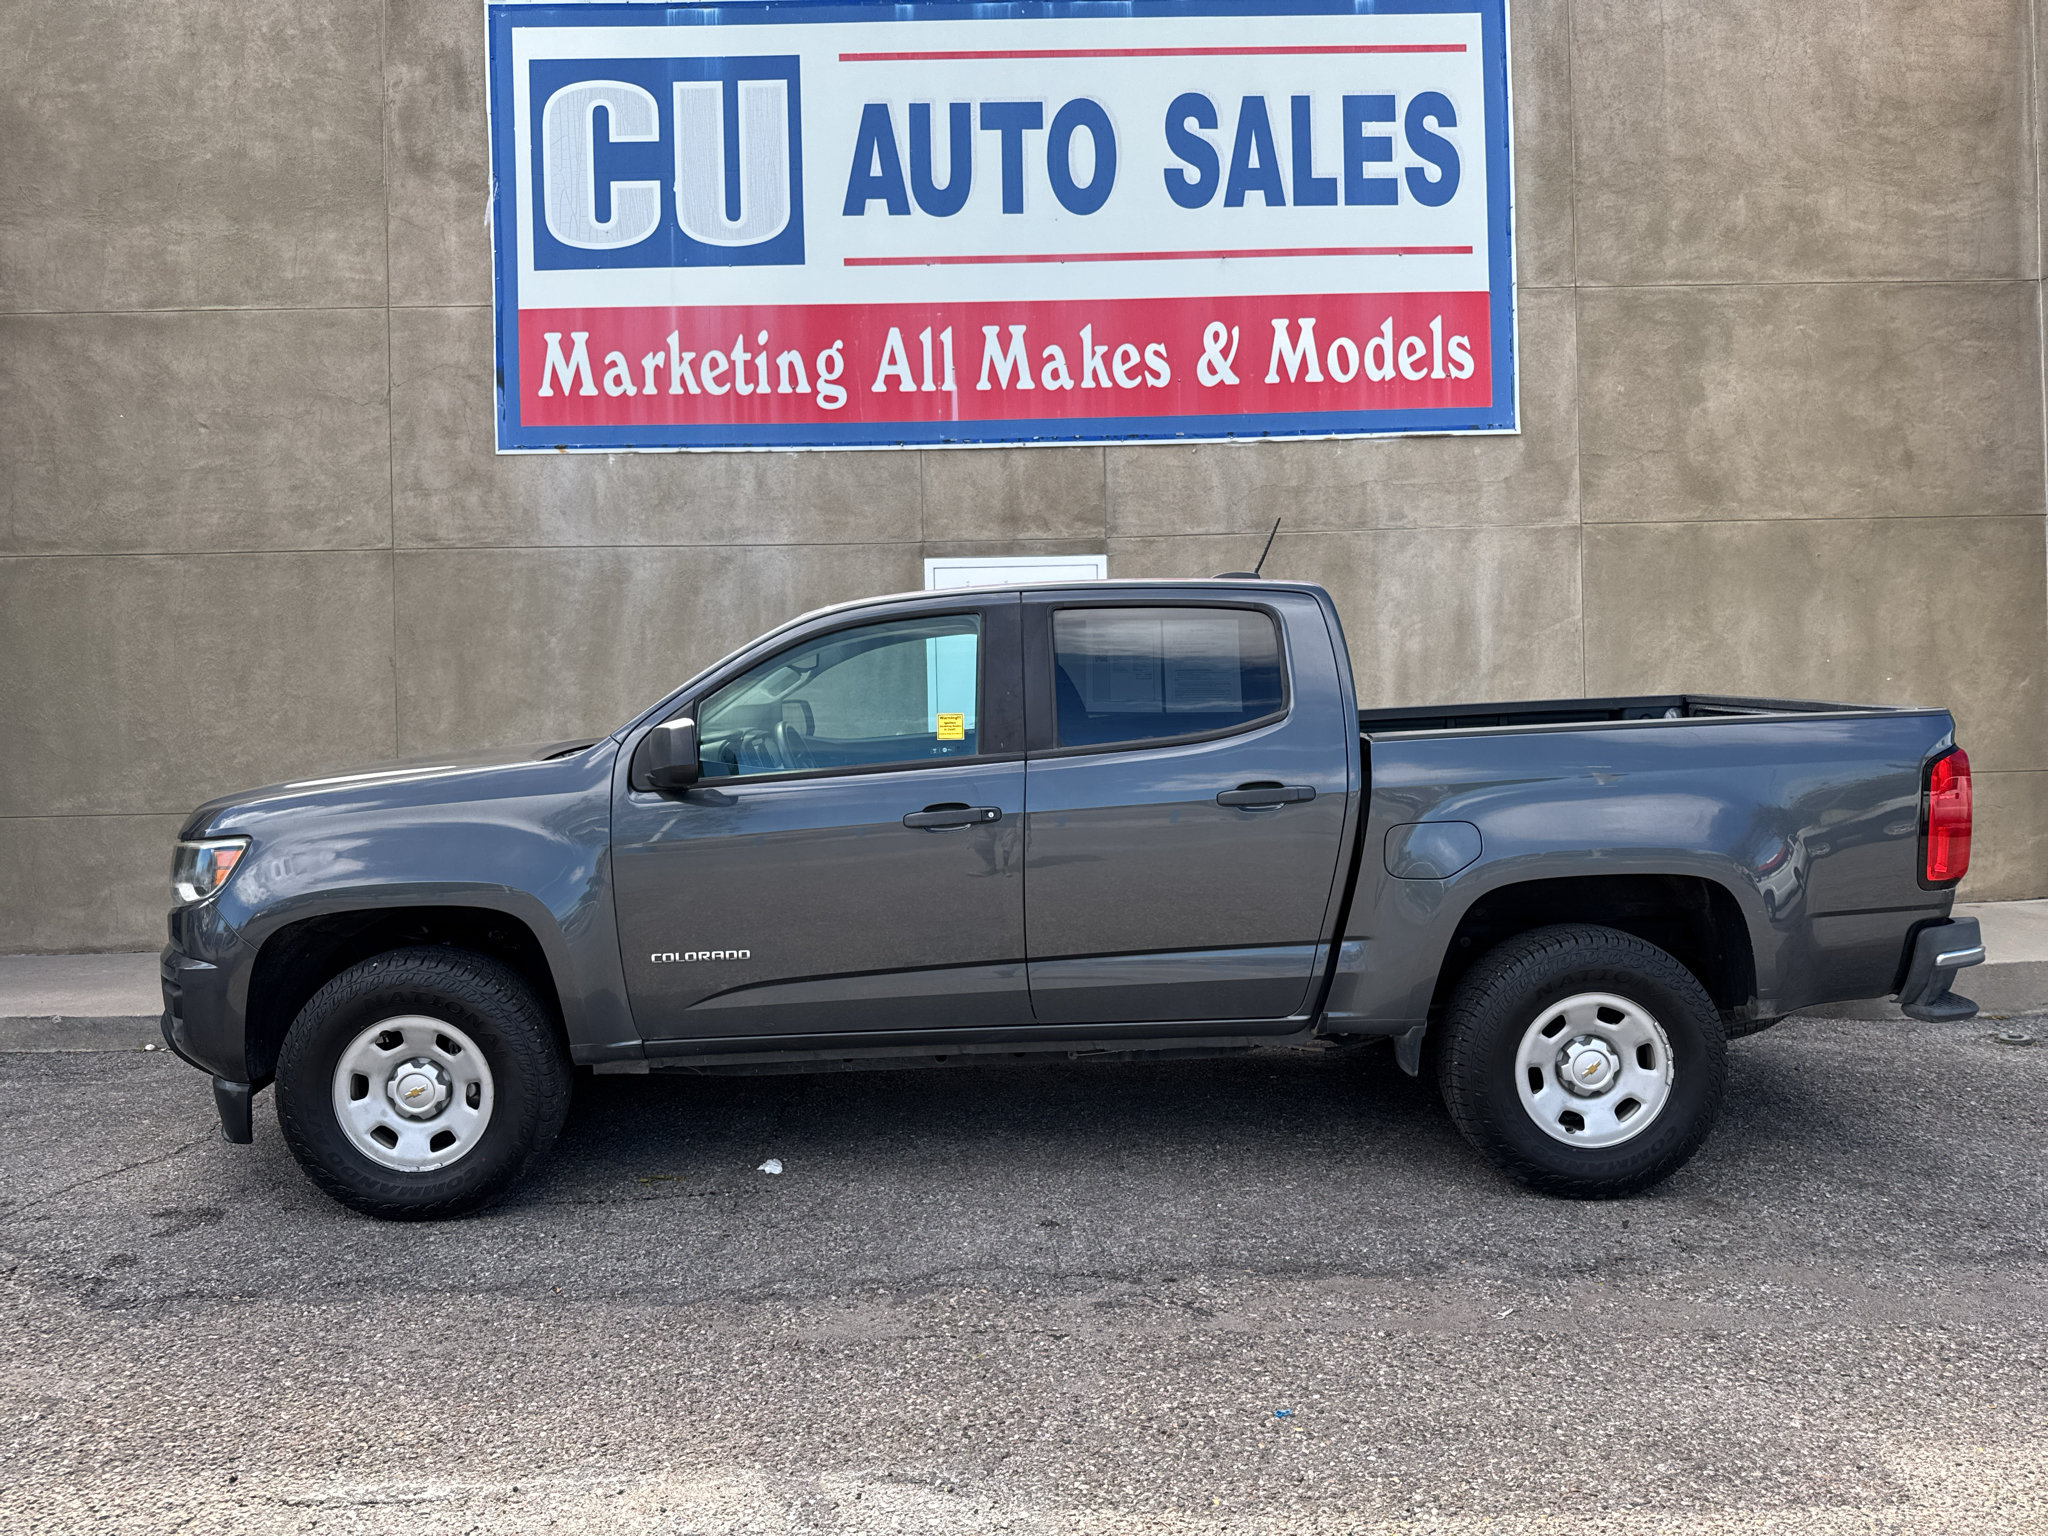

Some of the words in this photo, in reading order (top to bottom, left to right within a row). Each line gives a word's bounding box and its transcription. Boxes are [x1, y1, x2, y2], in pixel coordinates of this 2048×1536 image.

[542, 79, 790, 250] CU
[842, 97, 1118, 218] AUTO
[1164, 91, 1461, 209] SALES
[538, 329, 848, 410] Marketing
[871, 326, 958, 393] All
[976, 323, 1171, 391] Makes
[1196, 321, 1240, 388] &
[1264, 315, 1475, 384] Models
[651, 950, 751, 963] COLORADO
